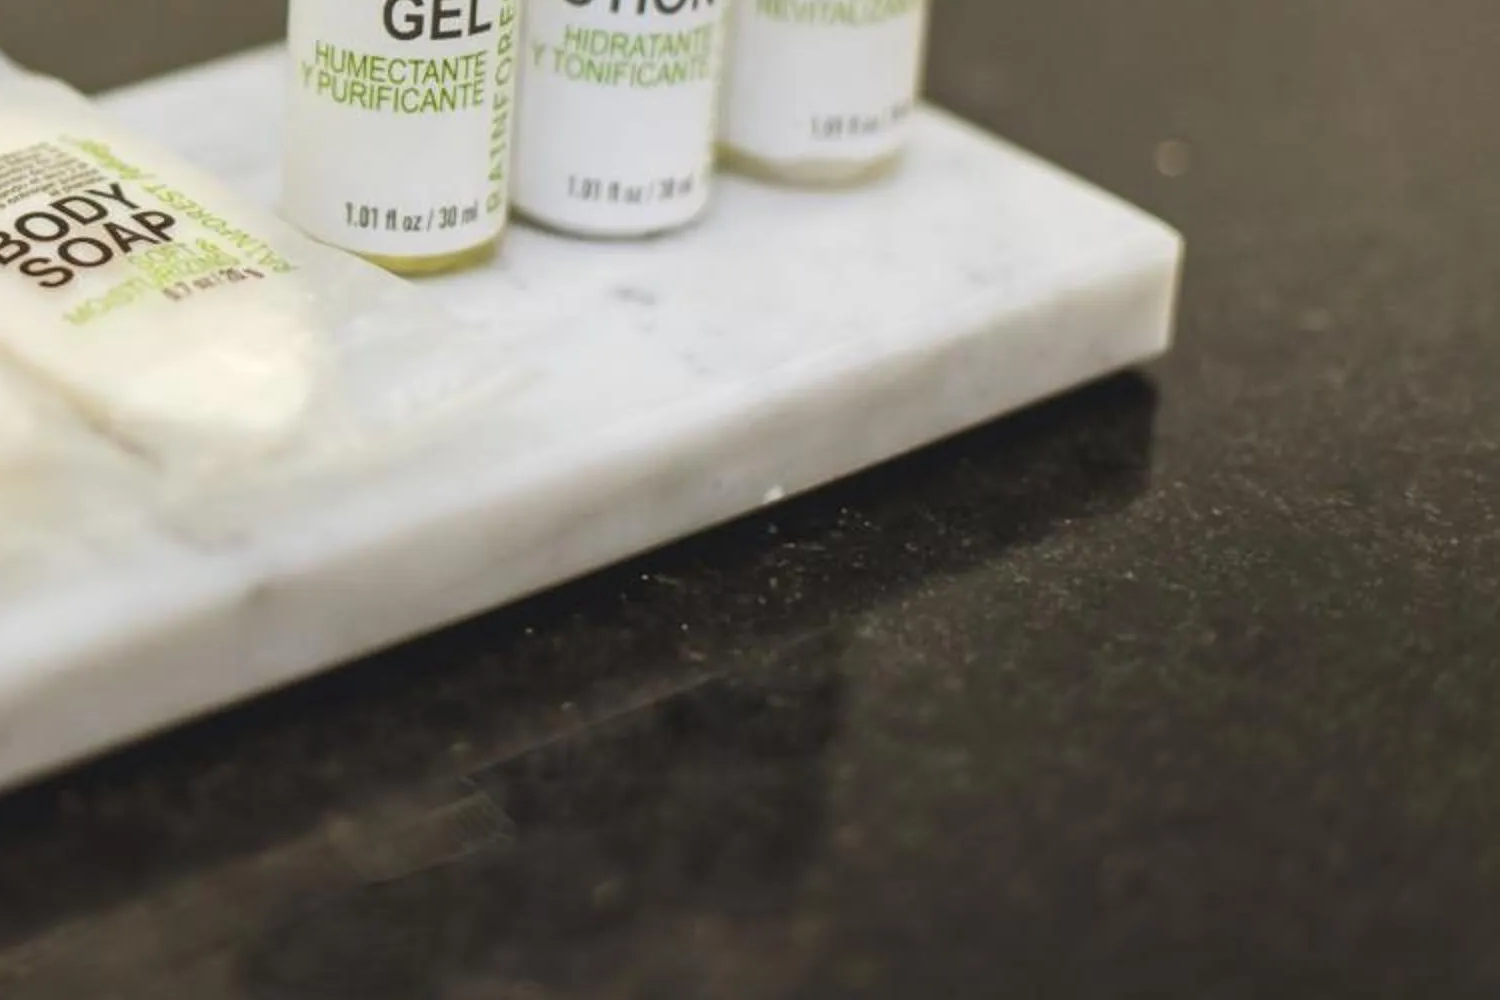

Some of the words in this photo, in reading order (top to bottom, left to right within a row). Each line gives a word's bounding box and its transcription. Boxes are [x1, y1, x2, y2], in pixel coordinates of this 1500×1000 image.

[315, 40, 489, 85] HUMECTANTE
[531, 42, 546, 68] Y
[318, 71, 486, 114] PURIFICANTE
[345, 201, 379, 231] 1.01
[385, 207, 397, 231] fl
[402, 215, 422, 232] oz
[438, 204, 458, 229] 30
[19, 210, 177, 288] SOAP
